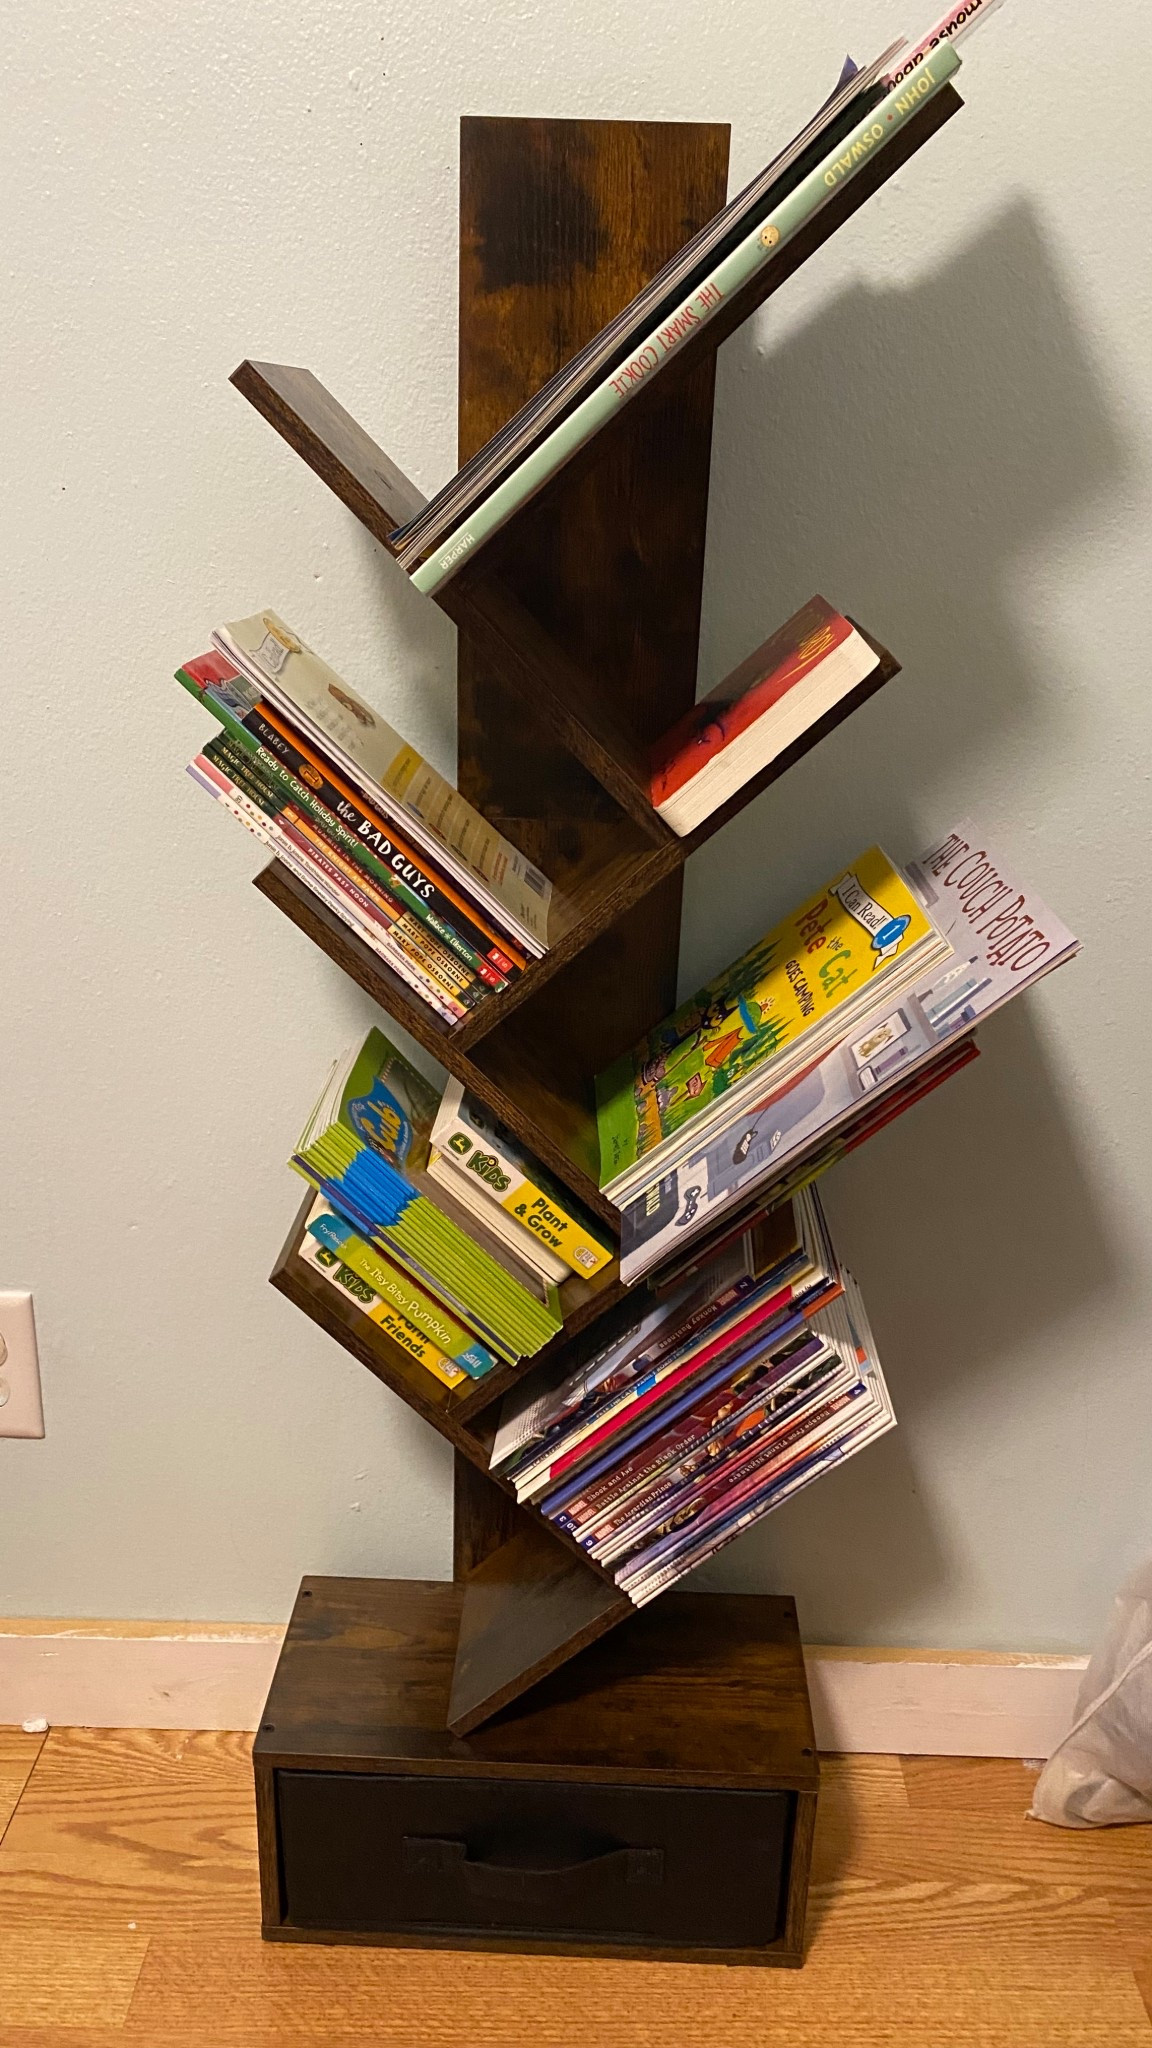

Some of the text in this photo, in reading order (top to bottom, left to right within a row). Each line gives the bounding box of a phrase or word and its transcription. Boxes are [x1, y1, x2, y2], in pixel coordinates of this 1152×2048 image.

[884, 52, 924, 92] abou
[821, 67, 936, 187] JOHN OSWALD
[608, 281, 724, 398] THE SMART COOKIE
[439, 534, 474, 569] HARPER
[257, 723, 289, 755] BLABEY
[335, 799, 359, 823] the
[356, 820, 393, 856] BAD
[389, 852, 436, 898] GUYS
[255, 747, 279, 771] Ready
[278, 770, 289, 781] to
[288, 779, 310, 801] Catch
[308, 800, 336, 826] Holiday
[334, 824, 358, 848] Spirit!
[425, 914, 445, 934] Wallace
[212, 755, 230, 773] MAGIC
[231, 773, 245, 788] TREE
[246, 788, 264, 805] HOUSE
[307, 848, 332, 872] PIRATES
[333, 873, 348, 887] PAST
[349, 888, 368, 906] NOON
[392, 931, 409, 947] MARY
[410, 948, 425, 963] POPE
[427, 964, 454, 990] OSBORNE
[221, 747, 239, 765] MAGIC
[240, 766, 254, 780] TREE
[255, 780, 273, 798] HOUSE
[401, 923, 418, 939] MARY
[419, 940, 434, 955] POPE
[436, 956, 463, 982] OSBORNE
[363, 874, 393, 902] MORNING
[922, 834, 1050, 971] THE COUCH POTATO
[795, 898, 832, 954] Pete
[844, 890, 860, 912] Can
[858, 902, 887, 930] Read!
[827, 936, 843, 951] the
[785, 960, 815, 1017] GOES CAMPING
[819, 950, 857, 998] Cat
[514, 1204, 562, 1247] & Grow
[530, 1198, 568, 1232] Plant
[360, 1258, 452, 1344] The Itsy Bitsy Pumpkin
[690, 1304, 716, 1324] Monkey
[380, 1314, 426, 1358] Friends
[659, 1323, 691, 1348] Business
[787, 1426, 804, 1441] from
[803, 1409, 829, 1429] Escape
[727, 1455, 764, 1483] Nightmare
[763, 1439, 787, 1457] Planet
[566, 1521, 576, 1531] 10
[595, 1491, 618, 1509] Battle
[617, 1471, 643, 1493] Against
[643, 1463, 655, 1474] the
[655, 1448, 676, 1465] Black
[675, 1434, 695, 1450] Order
[587, 1484, 607, 1501] Shock
[607, 1476, 619, 1486] and
[621, 1466, 633, 1476] Awe
[613, 1515, 625, 1525] The
[624, 1495, 652, 1518] Asgardian
[651, 1481, 671, 1497] Prince
